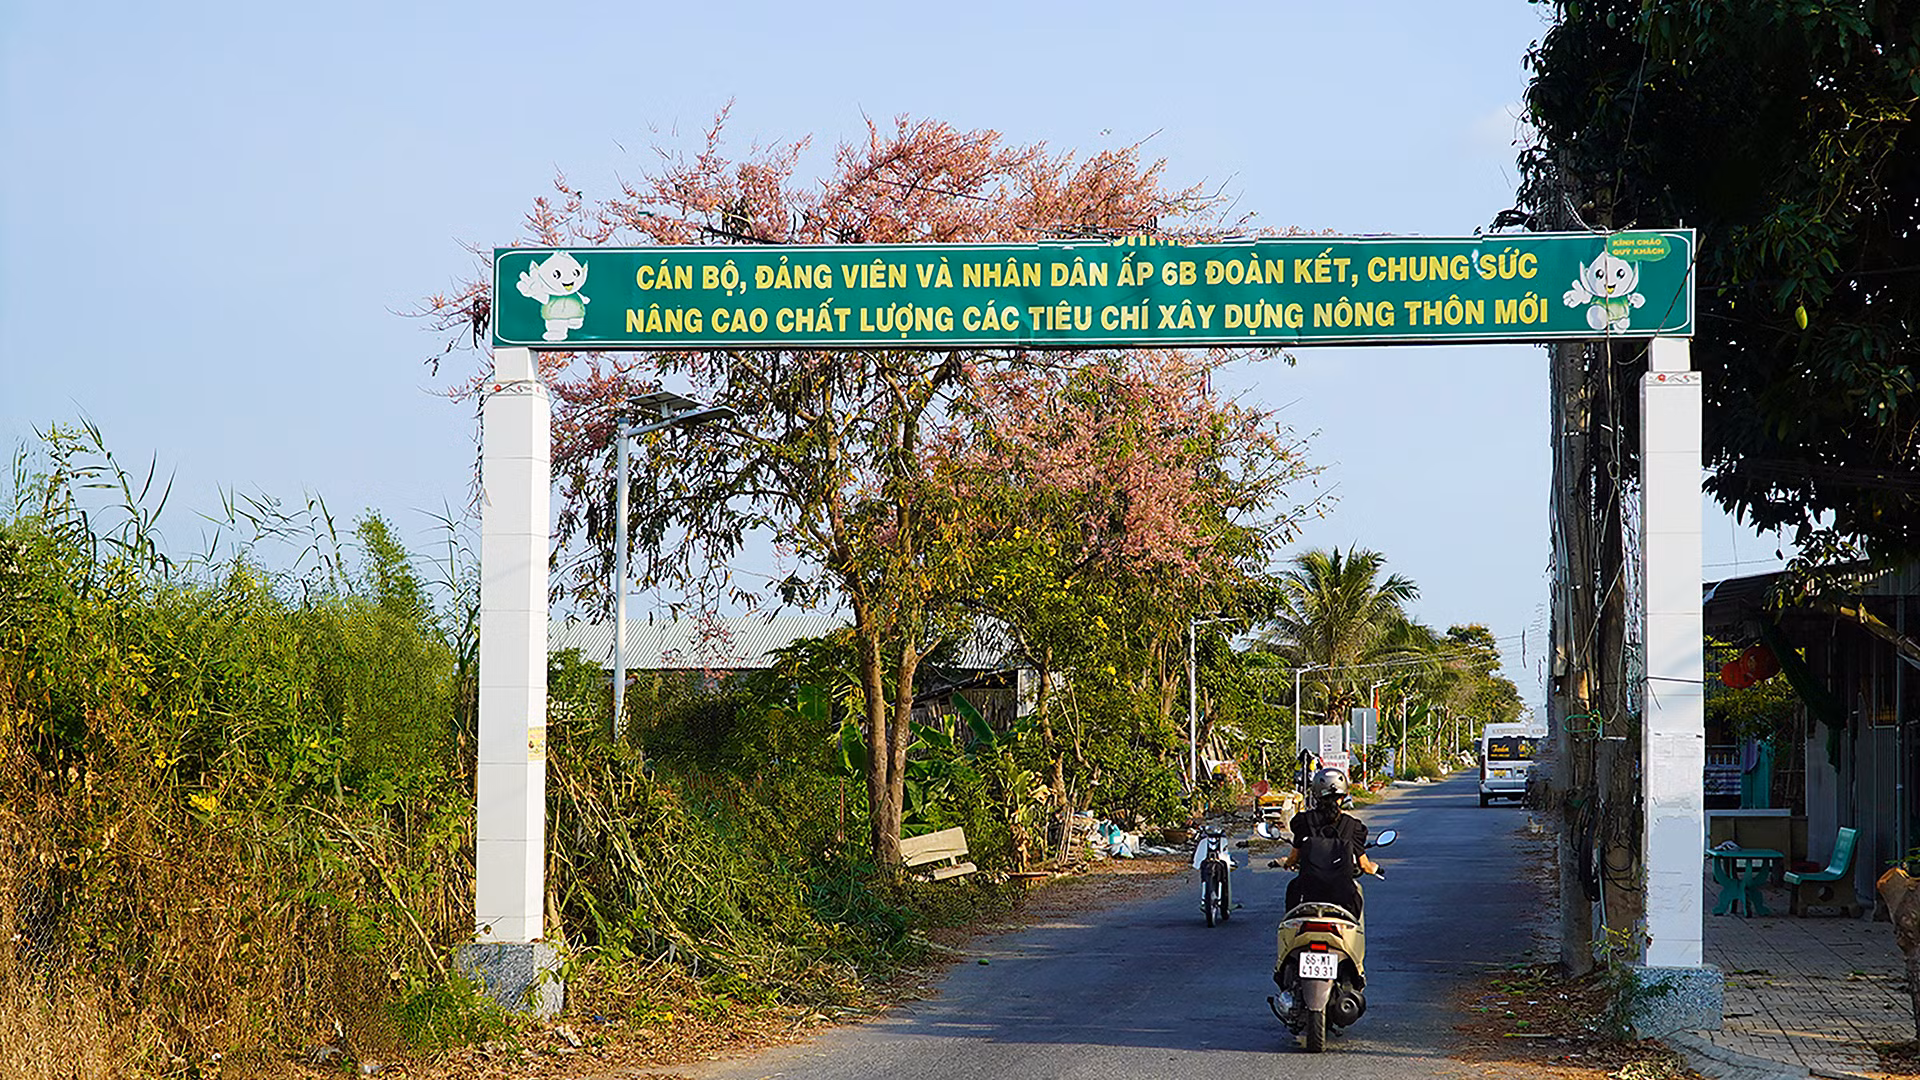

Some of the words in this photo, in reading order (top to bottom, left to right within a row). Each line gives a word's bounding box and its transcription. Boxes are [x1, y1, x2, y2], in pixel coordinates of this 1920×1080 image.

[636, 257, 693, 290] CÁN
[702, 258, 747, 297] BỘ,
[754, 255, 833, 289] ĐẢNG
[841, 258, 907, 289] VIÊN
[915, 256, 953, 289] VÀ
[962, 257, 1041, 288] NHÂN
[1050, 256, 1108, 287] DÂN
[1116, 251, 1155, 287] ẤP
[1160, 261, 1197, 286] 6B
[1205, 253, 1284, 285] ĐOÀN
[1293, 247, 1359, 287] KẾT,
[1367, 255, 1469, 283] CHUNG
[1479, 247, 1538, 281] SỨC
[625, 303, 703, 333] NÂNG
[710, 307, 769, 333] CAO
[775, 299, 851, 333] CHẤT
[859, 303, 953, 339] LƯỢNG
[962, 299, 1019, 331] CÁC
[1029, 301, 1091, 331] TIÊU
[1101, 298, 1149, 330] CHÍ
[1158, 298, 1215, 329] XÂY
[1225, 299, 1303, 335] DỰNG
[1313, 297, 1395, 327] NÔNG
[1403, 294, 1485, 326] THÔN
[1495, 291, 1548, 325] MỚI
